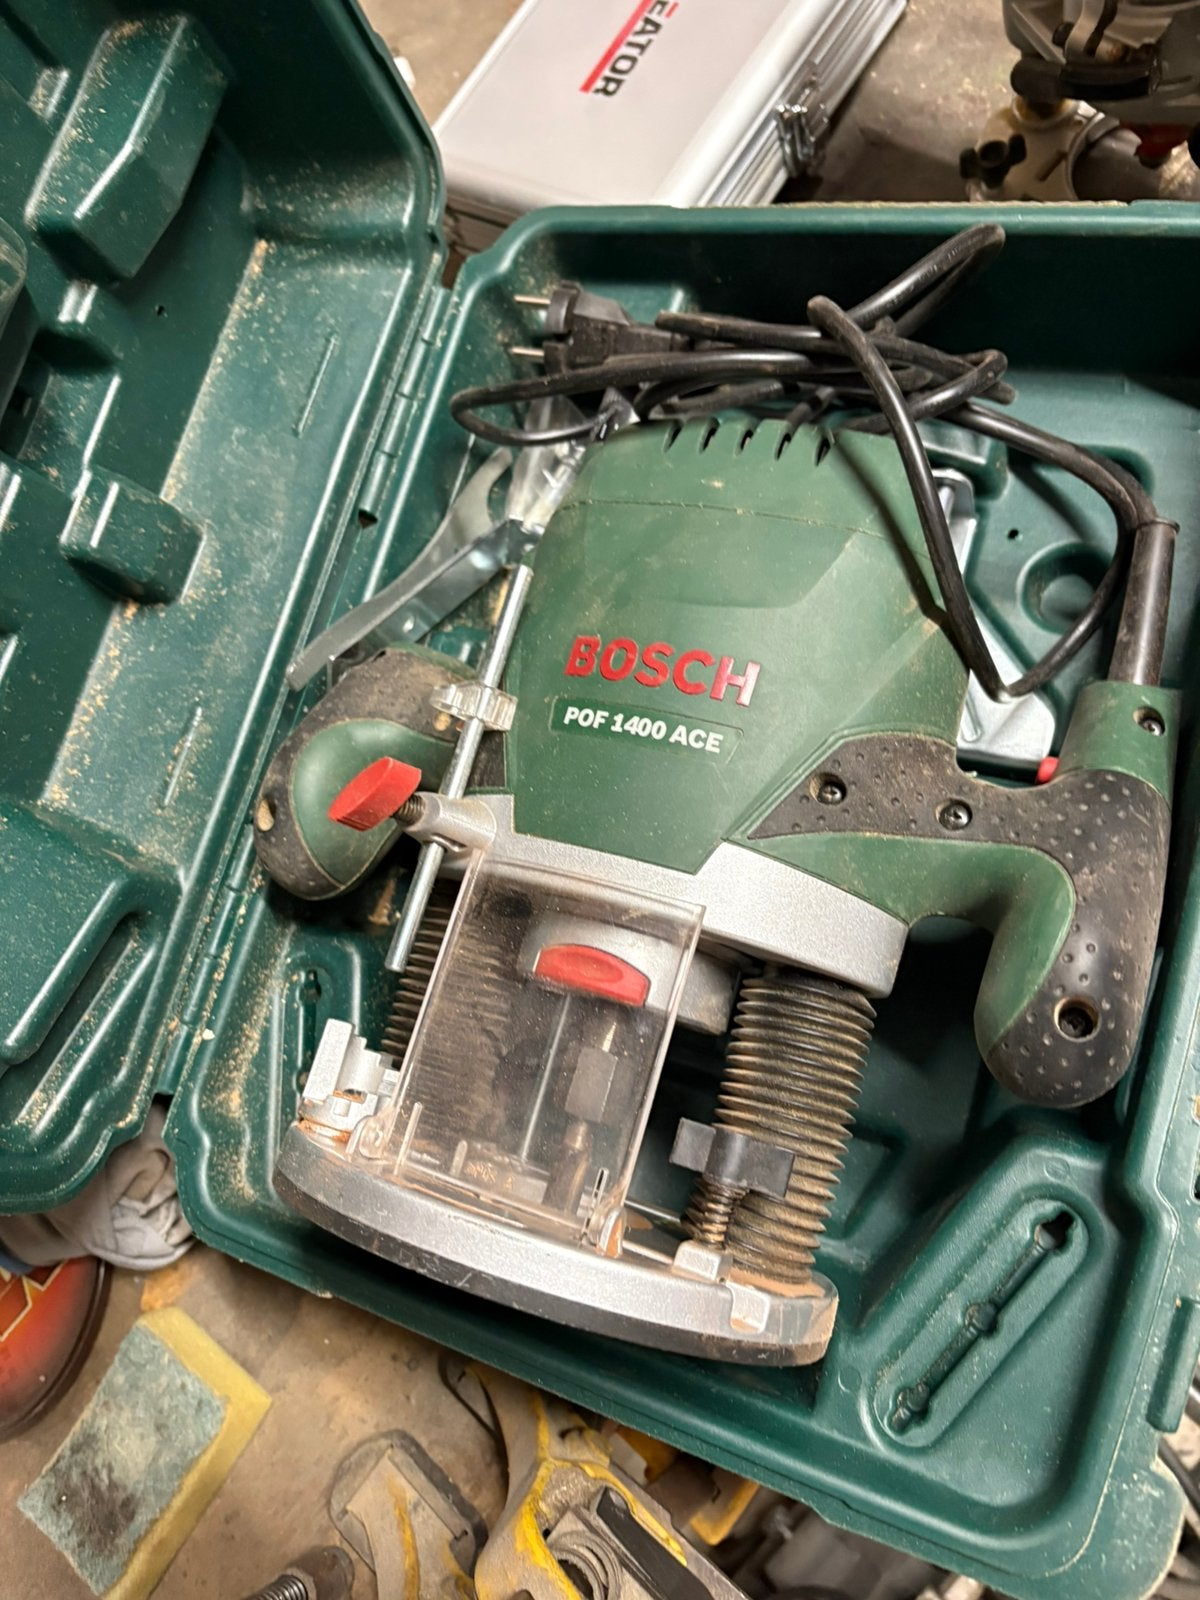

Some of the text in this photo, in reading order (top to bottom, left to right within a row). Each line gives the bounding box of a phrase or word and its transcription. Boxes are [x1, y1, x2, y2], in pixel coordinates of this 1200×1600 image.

[565, 635, 760, 707] BOSCH
[563, 706, 724, 753] POF 1400 ACE
